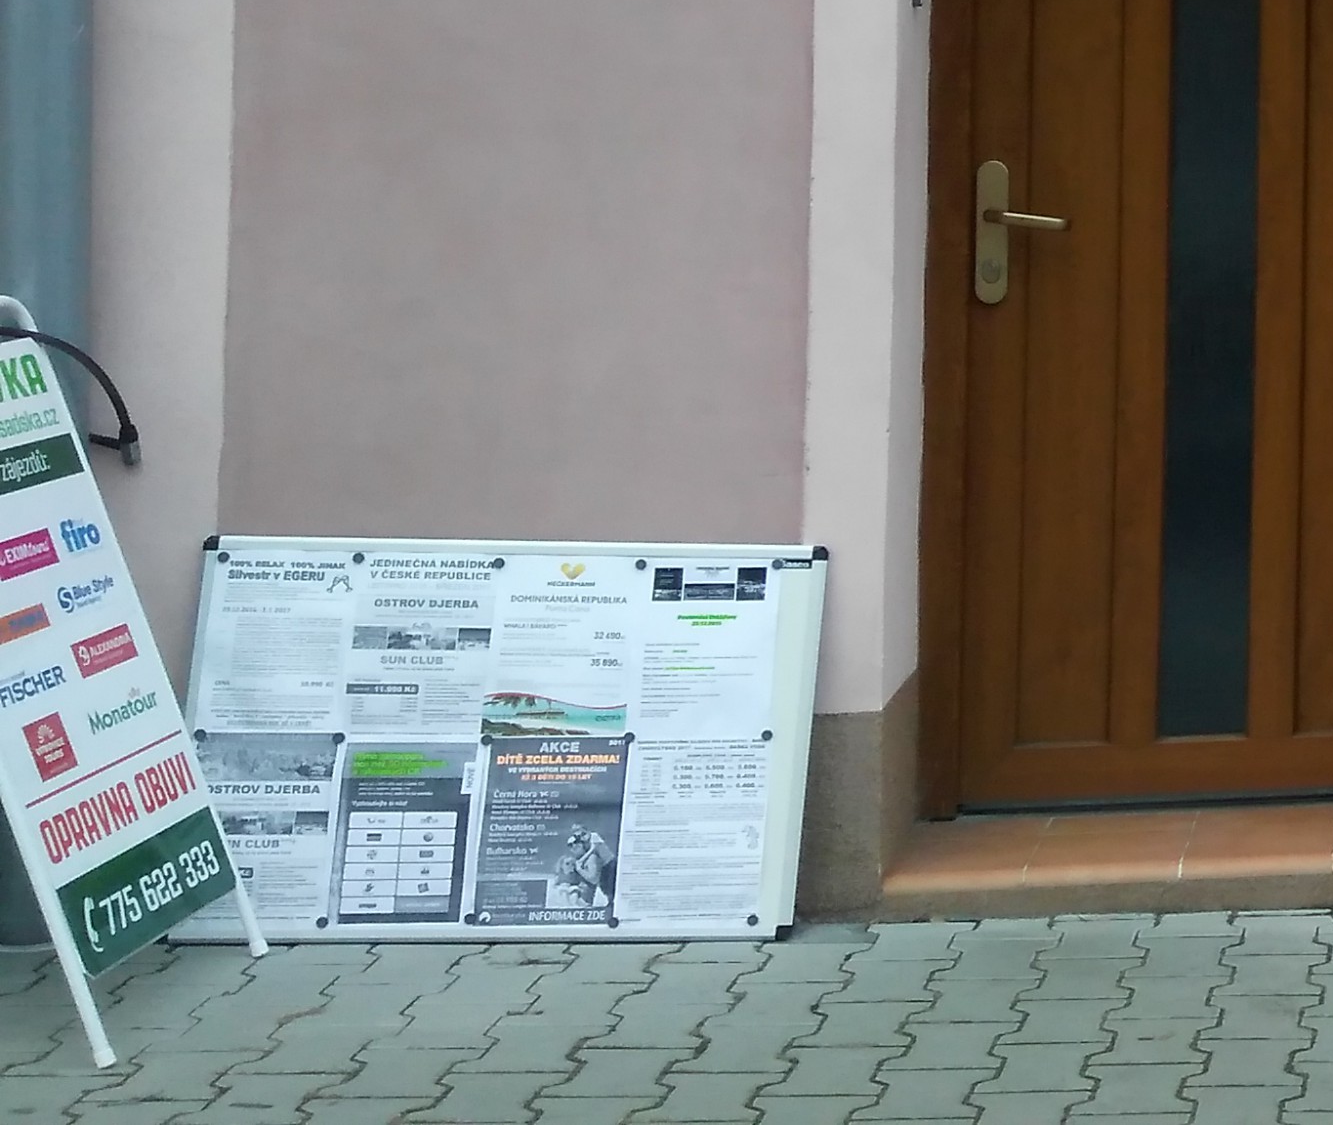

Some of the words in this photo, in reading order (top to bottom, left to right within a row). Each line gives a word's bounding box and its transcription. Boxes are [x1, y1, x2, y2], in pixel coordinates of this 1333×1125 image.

[60, 518, 101, 553] firo
[440, 558, 494, 570] NABÍDKA
[227, 569, 271, 580] Silvestr
[273, 571, 281, 580] v
[283, 570, 325, 581] EGERU
[370, 570, 378, 579] V
[381, 569, 420, 580] ČESKÉ
[423, 571, 492, 581] REPUBLICE
[72, 584, 92, 600] Blue
[91, 574, 115, 594] Style
[374, 598, 426, 608] OSTROV
[428, 599, 479, 609] DJERBA
[510, 594, 580, 604] DOMINIKÁNSKÁ
[581, 595, 628, 605] REPUBLIKA
[379, 655, 407, 665] SUN
[410, 655, 444, 665] CLUB
[590, 658, 602, 667] 35
[0, 665, 67, 708] FISCHER
[87, 691, 158, 736] Monatour
[539, 741, 580, 753] AKCE
[497, 753, 524, 765] DÍTĚ
[525, 754, 564, 764] ZCELA
[565, 754, 620, 764] ZDARMA!
[264, 784, 321, 794] DJERBA
[39, 781, 139, 865] OPRAVNA
[134, 751, 197, 815] OBUVI
[245, 839, 280, 849] CLUB
[99, 884, 143, 935] 775
[139, 861, 184, 913] 622
[178, 839, 221, 889] 333
[528, 910, 585, 922] INFORMACE
[587, 909, 606, 921] ZDE
